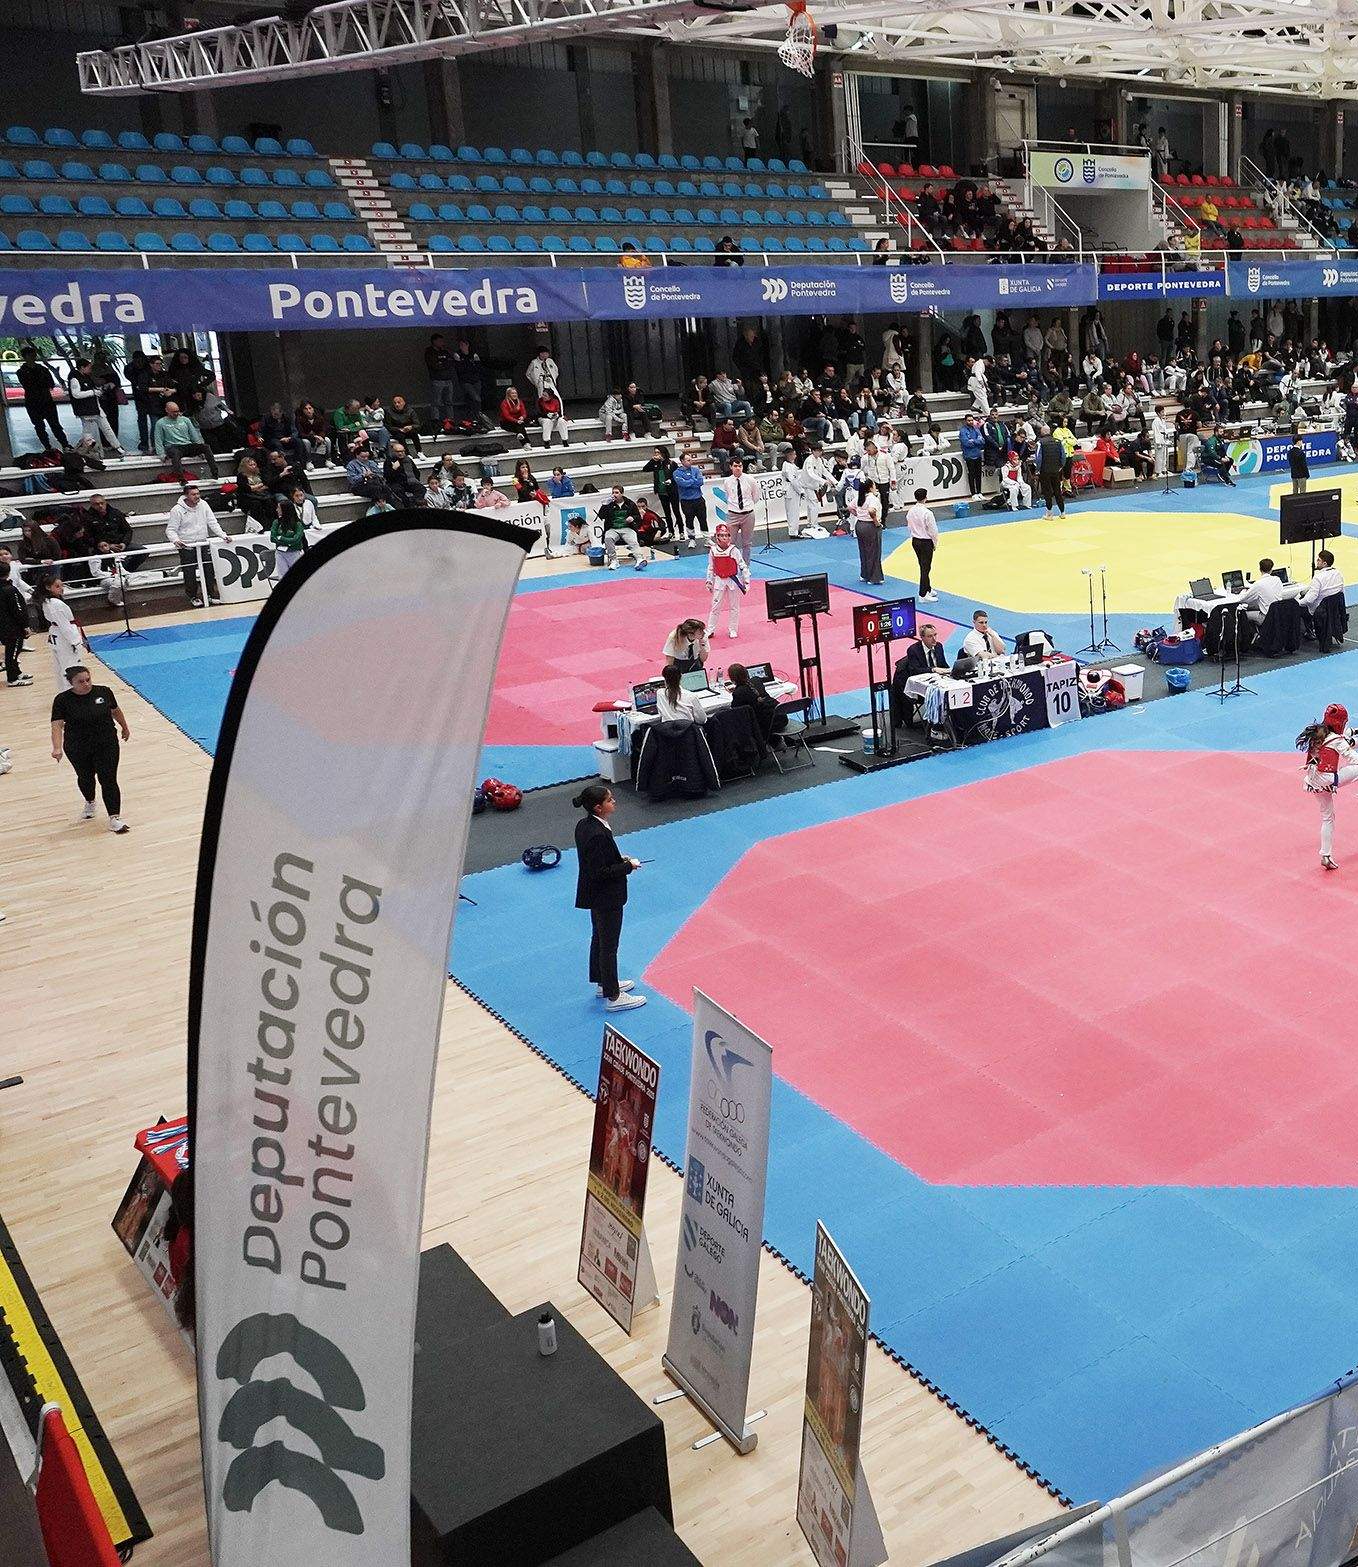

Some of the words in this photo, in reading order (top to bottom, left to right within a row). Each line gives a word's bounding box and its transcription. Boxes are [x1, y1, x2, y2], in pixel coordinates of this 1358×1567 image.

[650, 285, 680, 293] Concello
[791, 280, 836, 290] Deputación
[910, 281, 935, 289] Concello
[919, 288, 950, 296] Pontevedra
[1107, 283, 1153, 291] DEPORTE
[1157, 280, 1221, 290] PONTEVEDRA
[268, 278, 539, 319] Pontevedra
[661, 292, 701, 300] Pontevedra
[791, 289, 836, 297] Pontevedra
[0, 282, 145, 324] edra
[1266, 442, 1312, 455] DEPOTE
[1266, 448, 1331, 462] PONEDRA
[867, 620, 875, 632] 0
[896, 615, 904, 627] 0
[1046, 677, 1078, 692] TAPIZ
[976, 694, 991, 716] CLUB
[1053, 691, 1071, 715] 10
[243, 851, 315, 1275] Deputación
[605, 1030, 657, 1088] TAEKWONDO
[300, 874, 383, 1291] Pontevedra
[706, 1173, 735, 1208] XUNTA
[705, 1189, 716, 1213] DE
[715, 1198, 750, 1243] GALICIA
[699, 1225, 726, 1257] DEPORTE
[817, 1229, 866, 1326] TAEKWONDO
